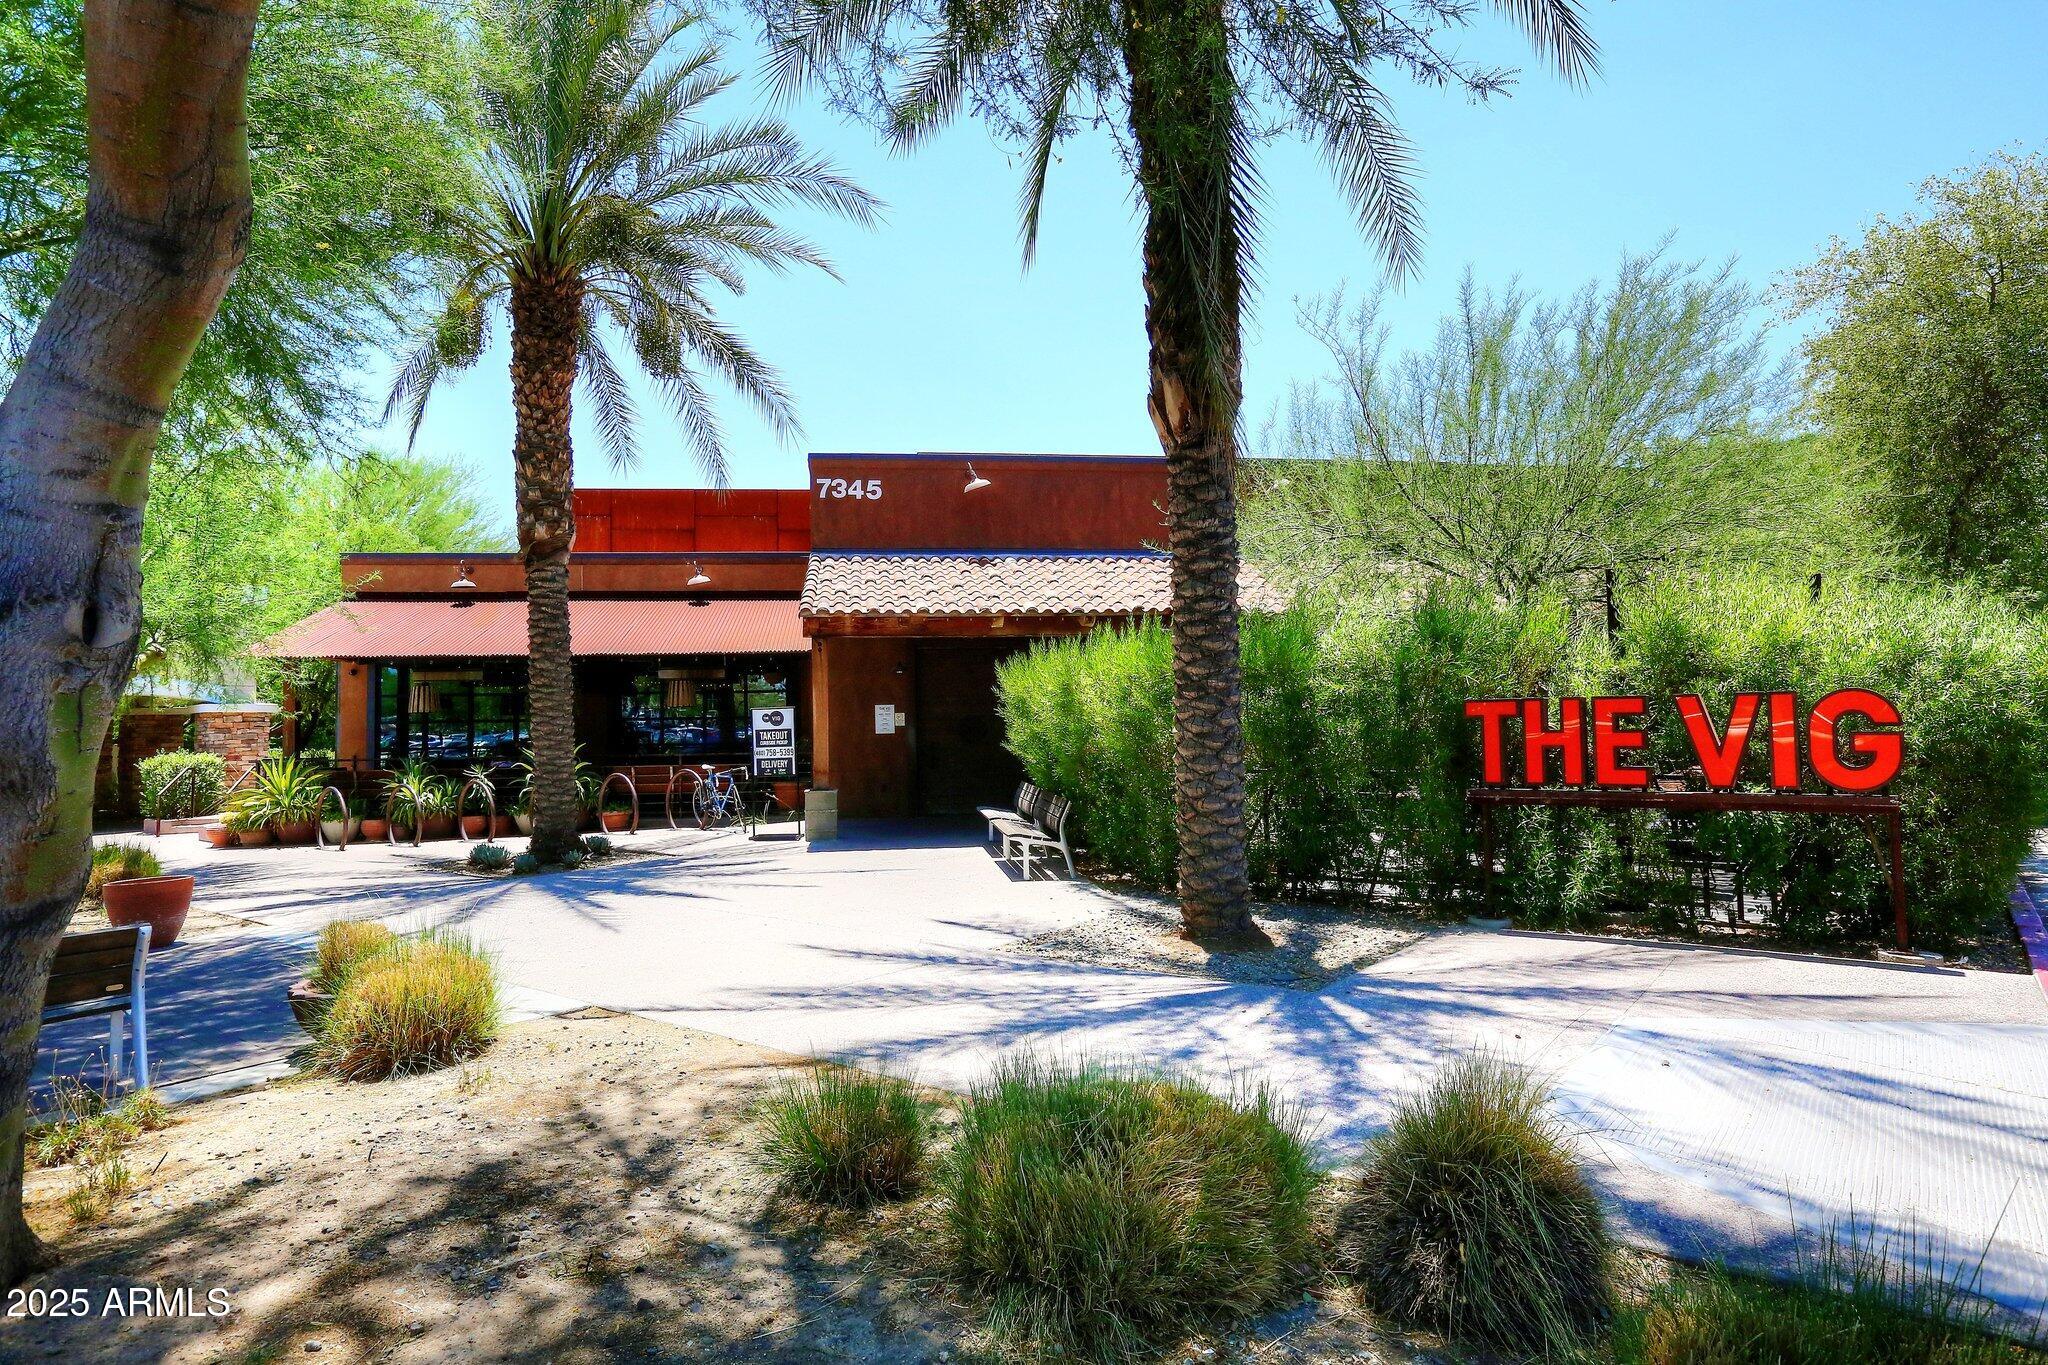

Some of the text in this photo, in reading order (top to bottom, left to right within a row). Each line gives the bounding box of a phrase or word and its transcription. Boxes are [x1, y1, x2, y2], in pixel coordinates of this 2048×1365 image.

[816, 478, 883, 500] 7345
[760, 731, 788, 740] TAKEOUT
[1464, 688, 1905, 791] THE VIG
[761, 760, 788, 768] DELIVERY
